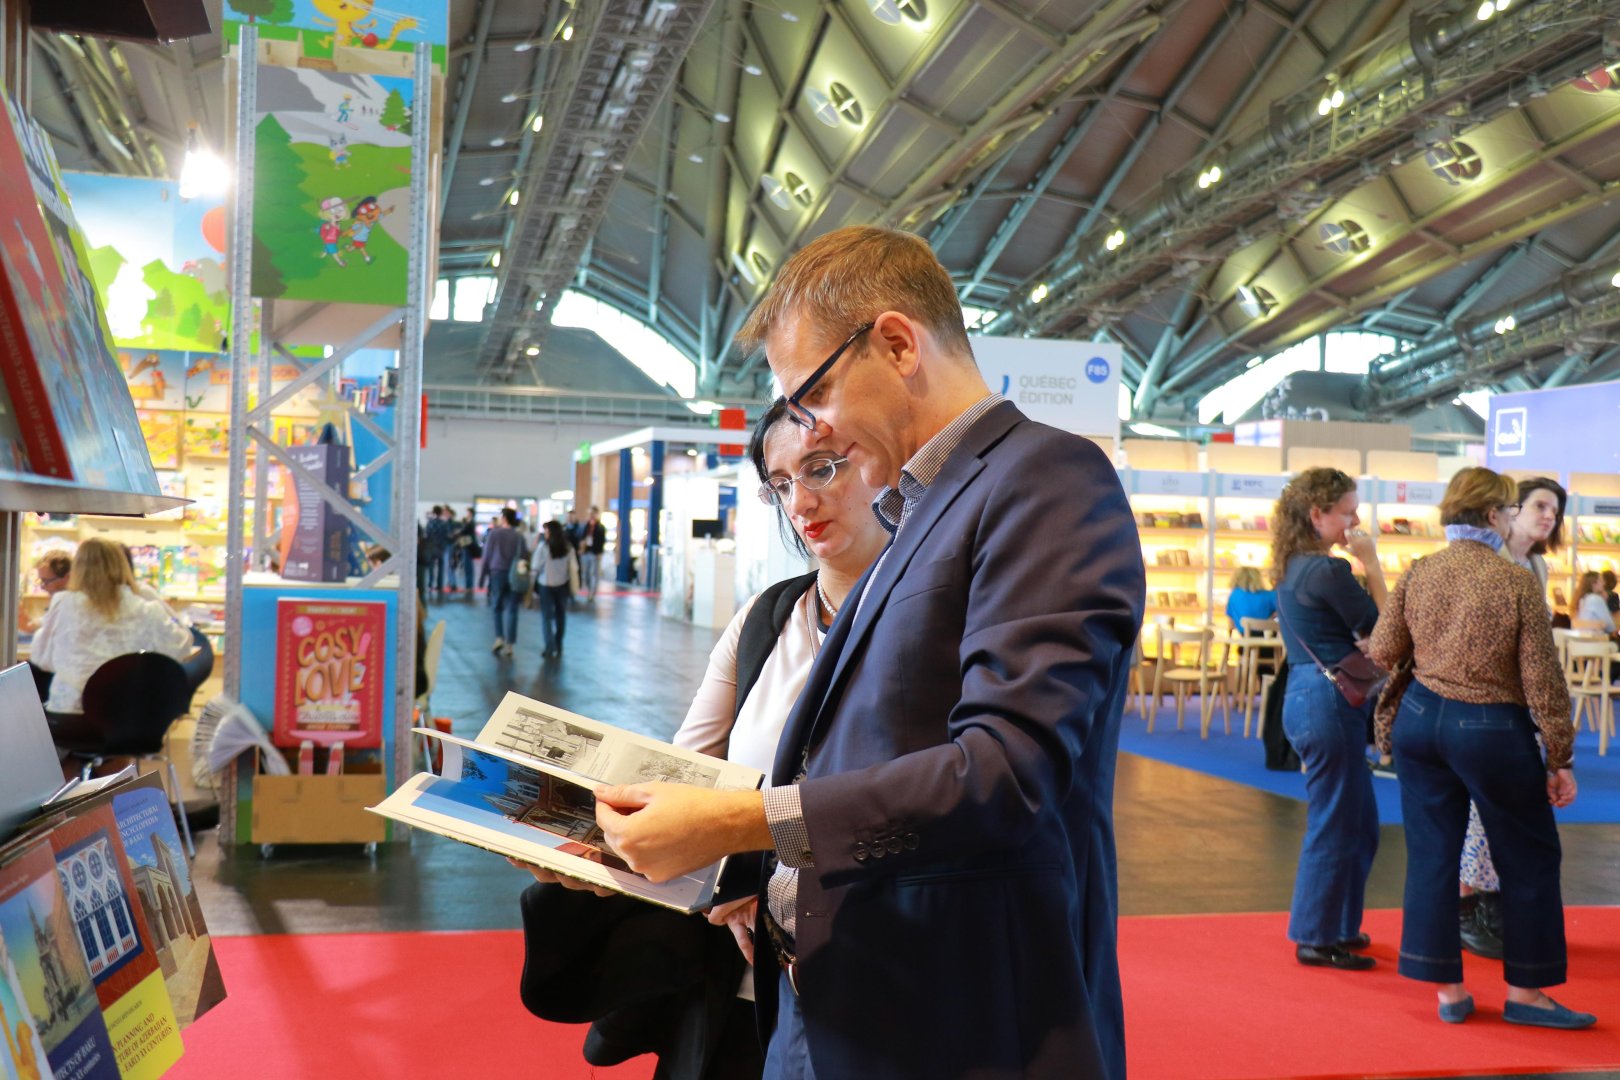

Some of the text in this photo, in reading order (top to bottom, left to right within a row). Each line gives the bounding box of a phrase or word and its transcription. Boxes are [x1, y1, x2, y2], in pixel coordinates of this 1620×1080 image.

[1019, 374, 1077, 390] QUÉBEC
[1019, 391, 1074, 405] ÉDITION
[297, 623, 365, 668] COSY
[294, 655, 366, 707] LOVE
[120, 815, 158, 838] NCYCLOPEDIA
[117, 1023, 143, 1049] PLANNING
[144, 1012, 155, 1026] AND
[118, 1047, 131, 1062] TURE
